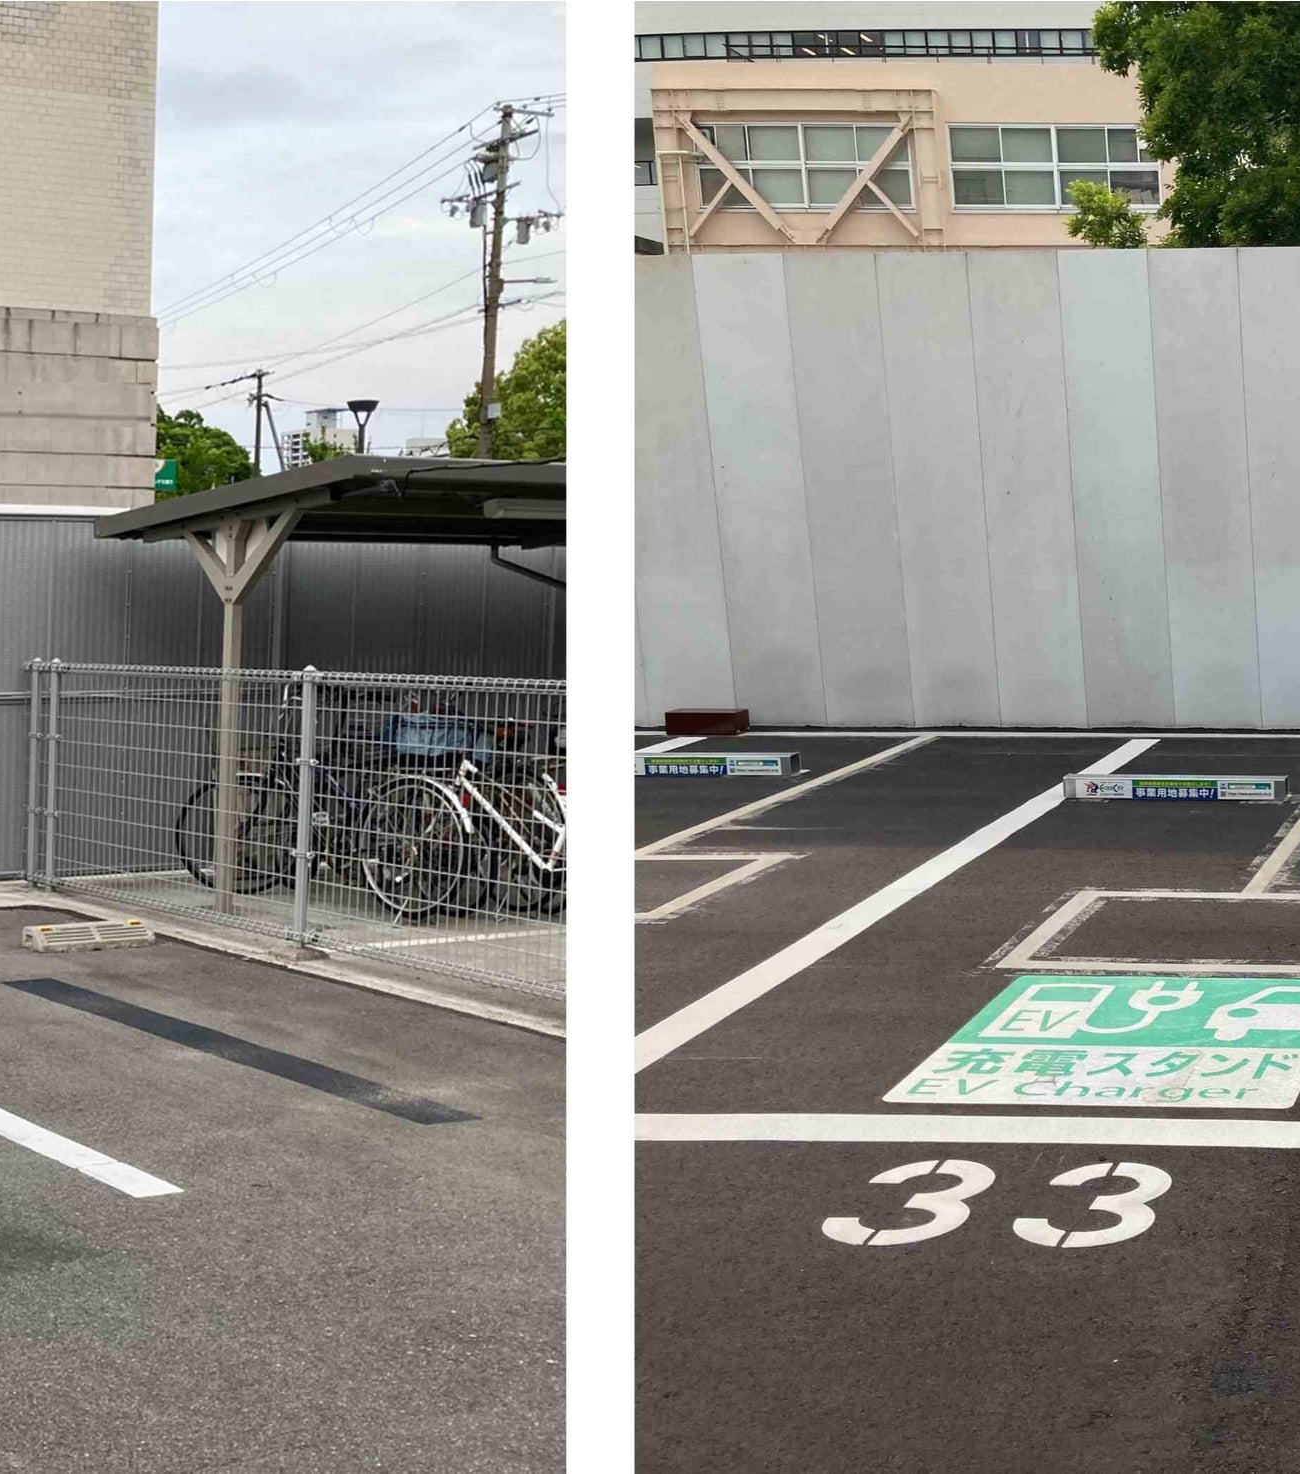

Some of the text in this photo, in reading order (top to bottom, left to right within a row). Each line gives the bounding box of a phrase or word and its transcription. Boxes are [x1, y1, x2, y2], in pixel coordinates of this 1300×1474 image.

[999, 1009, 1083, 1033] EV
[932, 1048, 1300, 1080] 充電スタンド
[906, 1078, 1260, 1103] EV Charger
